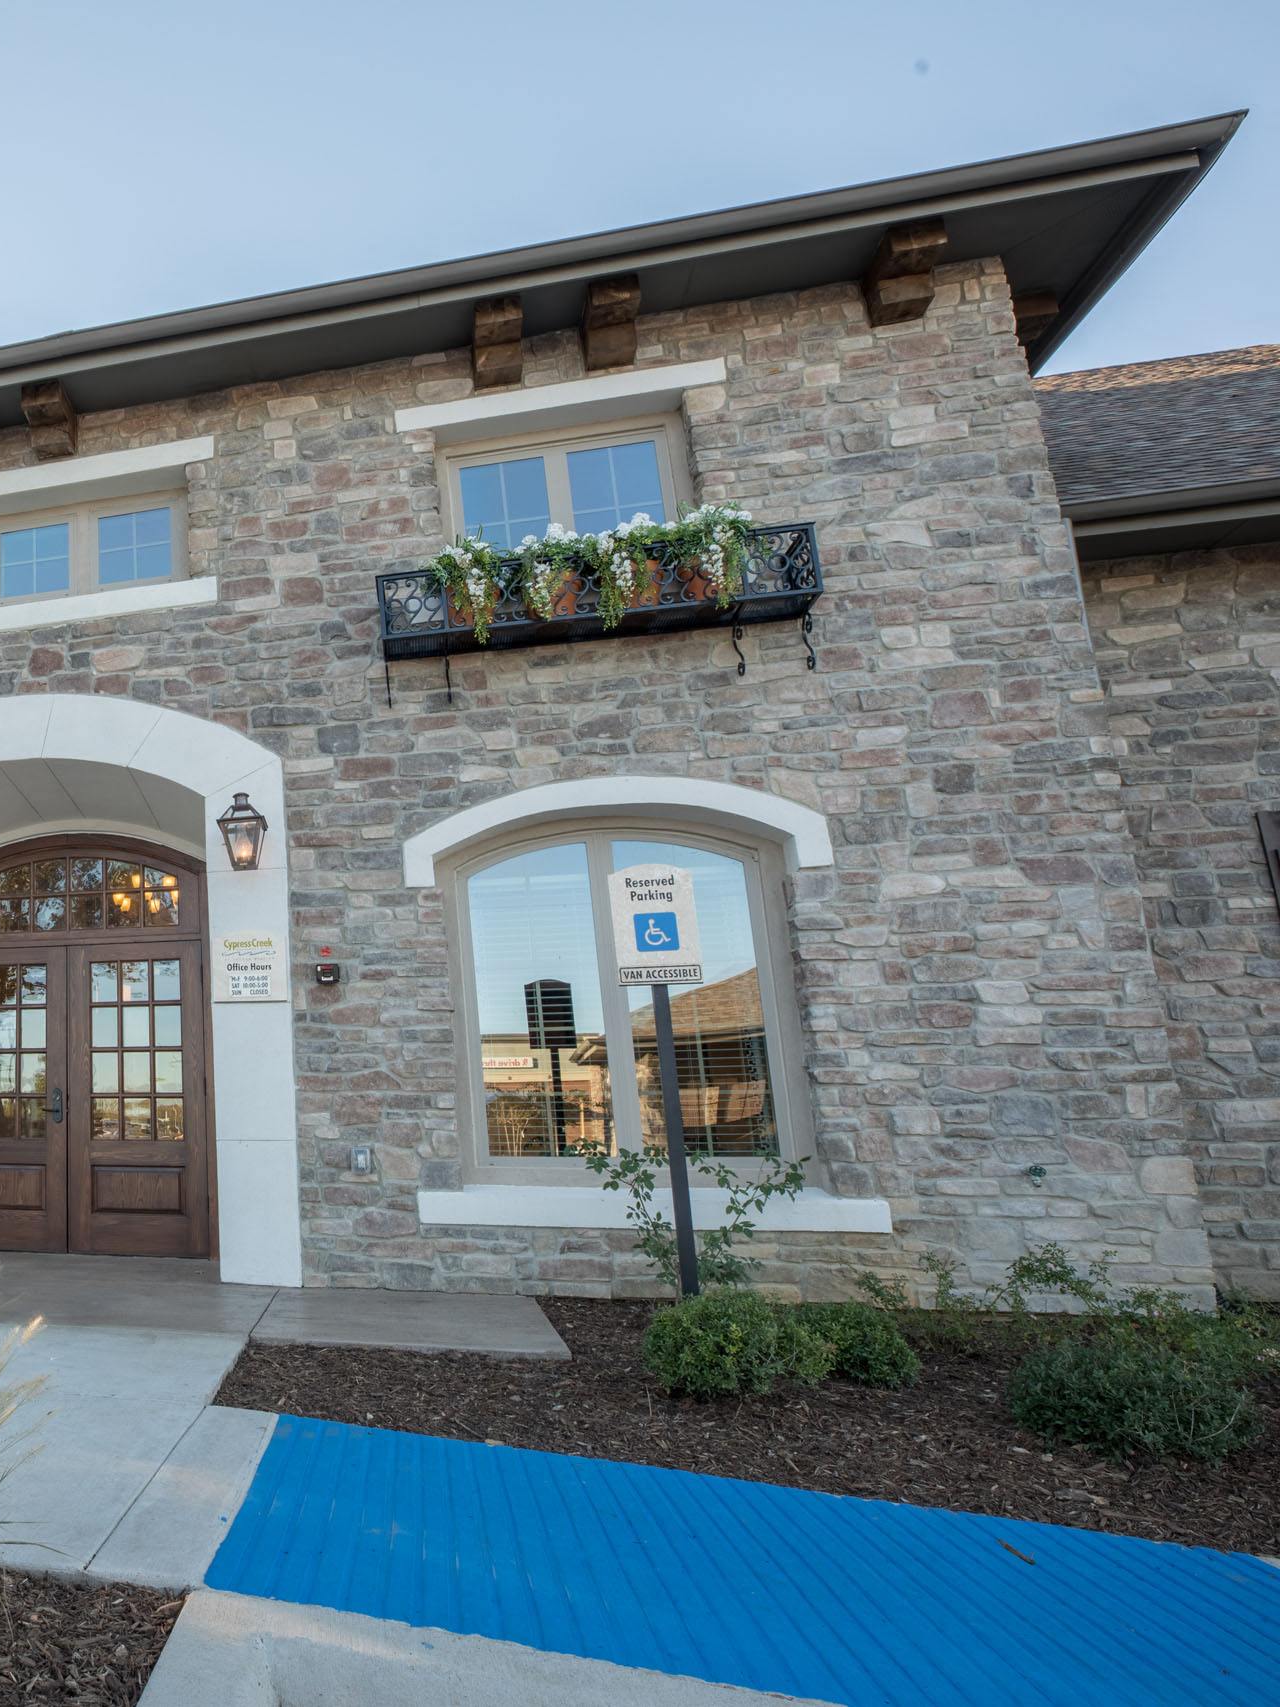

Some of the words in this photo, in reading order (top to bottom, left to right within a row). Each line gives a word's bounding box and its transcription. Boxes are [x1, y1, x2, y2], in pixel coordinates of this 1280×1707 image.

[625, 875, 675, 888] Reserved
[630, 890, 673, 902] Parking
[223, 939, 251, 950] Cypress
[226, 962, 249, 971] Office
[250, 962, 272, 971] Hours
[623, 970, 643, 980] VAN
[646, 968, 698, 979] ACCESSIBLE
